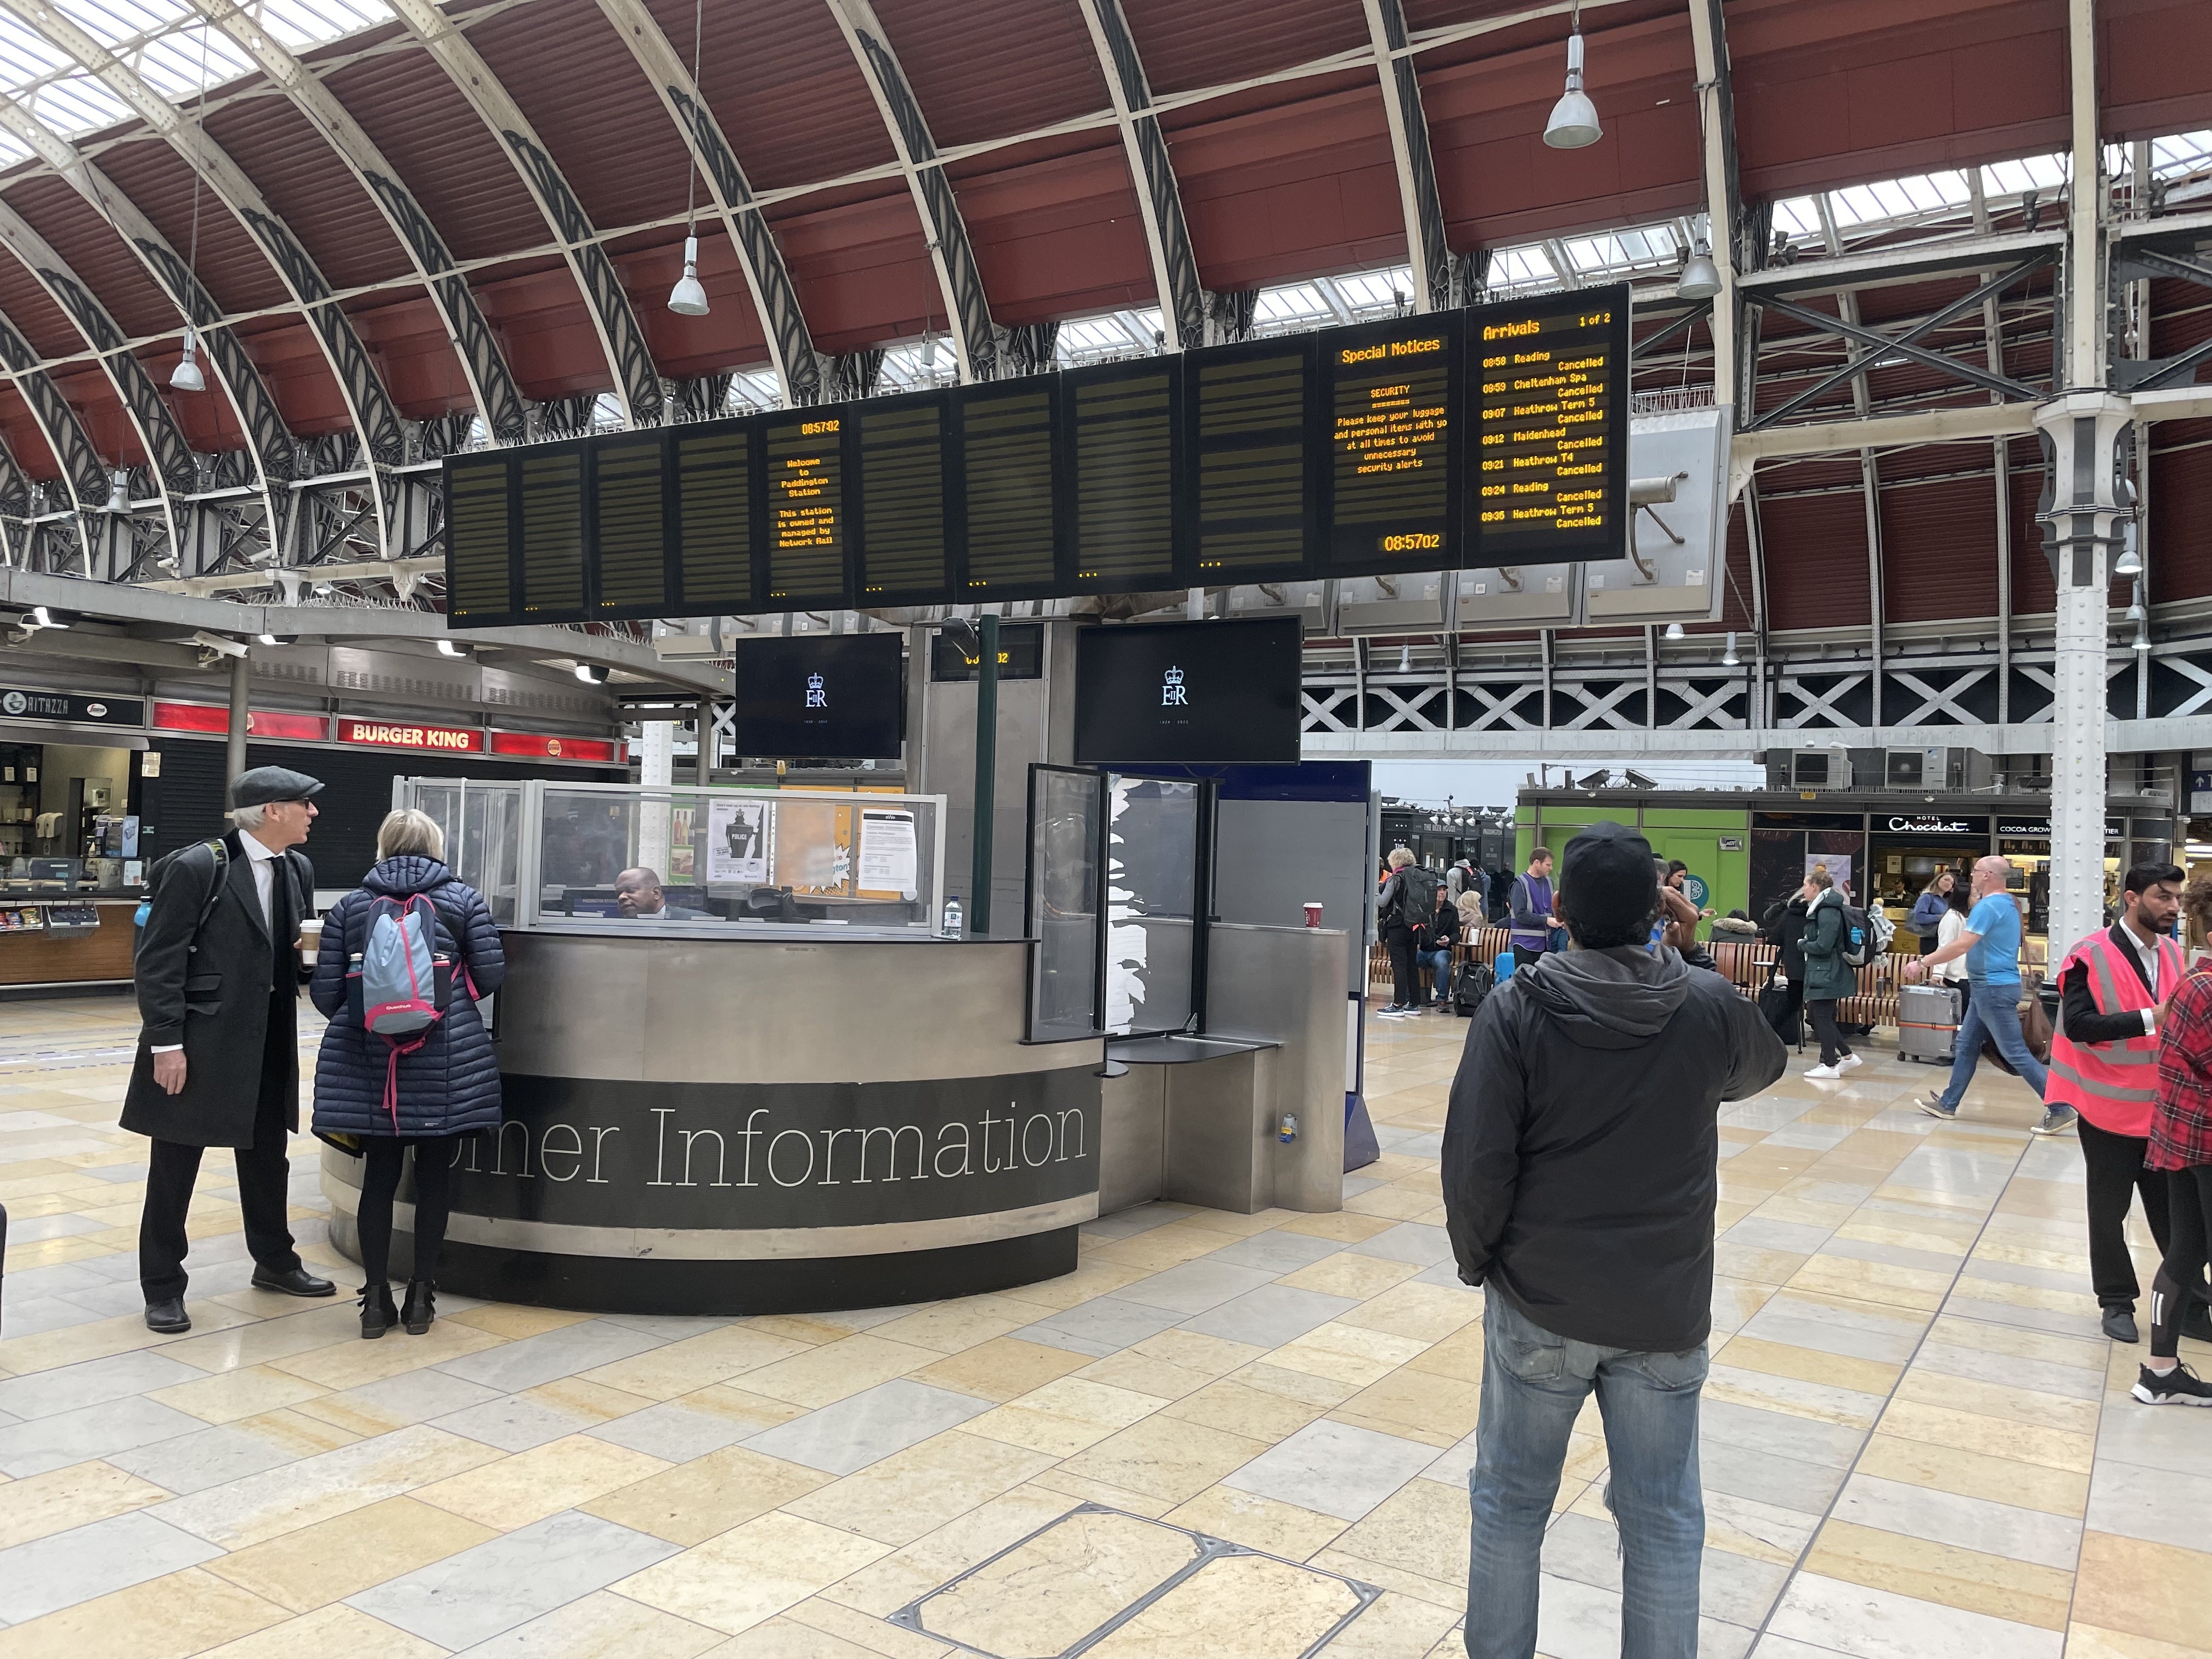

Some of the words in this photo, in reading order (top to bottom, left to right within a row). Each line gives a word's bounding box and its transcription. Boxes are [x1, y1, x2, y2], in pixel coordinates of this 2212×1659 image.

[1579, 316, 1585, 327] 1
[1589, 314, 1600, 325] of
[1604, 313, 1610, 323] 2
[1483, 319, 1540, 341] Arrivals
[1342, 344, 1386, 364] Special
[1391, 339, 1440, 356] Notices
[1514, 351, 1550, 364] Reading
[1558, 356, 1604, 371] Cancelled
[1514, 376, 1567, 390] Cheltenham
[1570, 373, 1587, 385] Spa
[1370, 385, 1410, 399] SECURITY
[1558, 383, 1603, 398] Cancelled
[1482, 408, 1506, 420] 09:07
[1514, 402, 1558, 416] Heathrow
[1561, 399, 1585, 410] Term
[1589, 397, 1595, 407] 5
[1338, 417, 1364, 427] Please
[1367, 415, 1386, 424] keep
[1389, 411, 1409, 421] your
[1413, 407, 1444, 418] luggage
[1558, 409, 1602, 424] Cancelled
[1334, 430, 1348, 439] and
[1351, 425, 1387, 438] personal
[1390, 424, 1413, 433] items
[1415, 419, 1434, 430] with
[1482, 433, 1504, 445] 09:12
[1514, 427, 1566, 442] Maidenhead
[1346, 441, 1357, 450] at
[1359, 439, 1370, 449] all
[1373, 438, 1396, 447] times
[1398, 436, 1409, 444] to
[1412, 432, 1435, 443] avoid
[1557, 436, 1602, 450] Cancelled
[1364, 448, 1417, 460] unnecessary
[1482, 459, 1504, 470] 09:21
[1513, 454, 1558, 467] Heathrow
[1560, 452, 1574, 462] T4
[787, 459, 820, 468] Welcome
[1357, 462, 1393, 473] security
[1396, 459, 1423, 469] alerts
[1556, 462, 1602, 476] Cancelled
[781, 478, 828, 488] Paddington
[1482, 485, 1505, 496] 09:24
[1513, 482, 1549, 493] Reading
[788, 488, 821, 498] Station
[1556, 489, 1601, 502] Cancelled
[779, 510, 797, 518] This
[800, 507, 832, 516] station
[1513, 506, 1558, 519] Heathrow
[1560, 504, 1584, 515] Term
[1587, 503, 1594, 513] 5
[789, 518, 815, 527] owned
[818, 516, 834, 524] and
[1556, 515, 1601, 528] Cancelled
[781, 527, 816, 537] managed
[819, 527, 830, 535] by
[779, 538, 812, 547] Network
[816, 537, 833, 545] Rail
[353, 724, 424, 746] BURGER
[427, 729, 469, 749] KING
[1442, 825, 1456, 833] HOUSE
[645, 1101, 1087, 1188] Information
